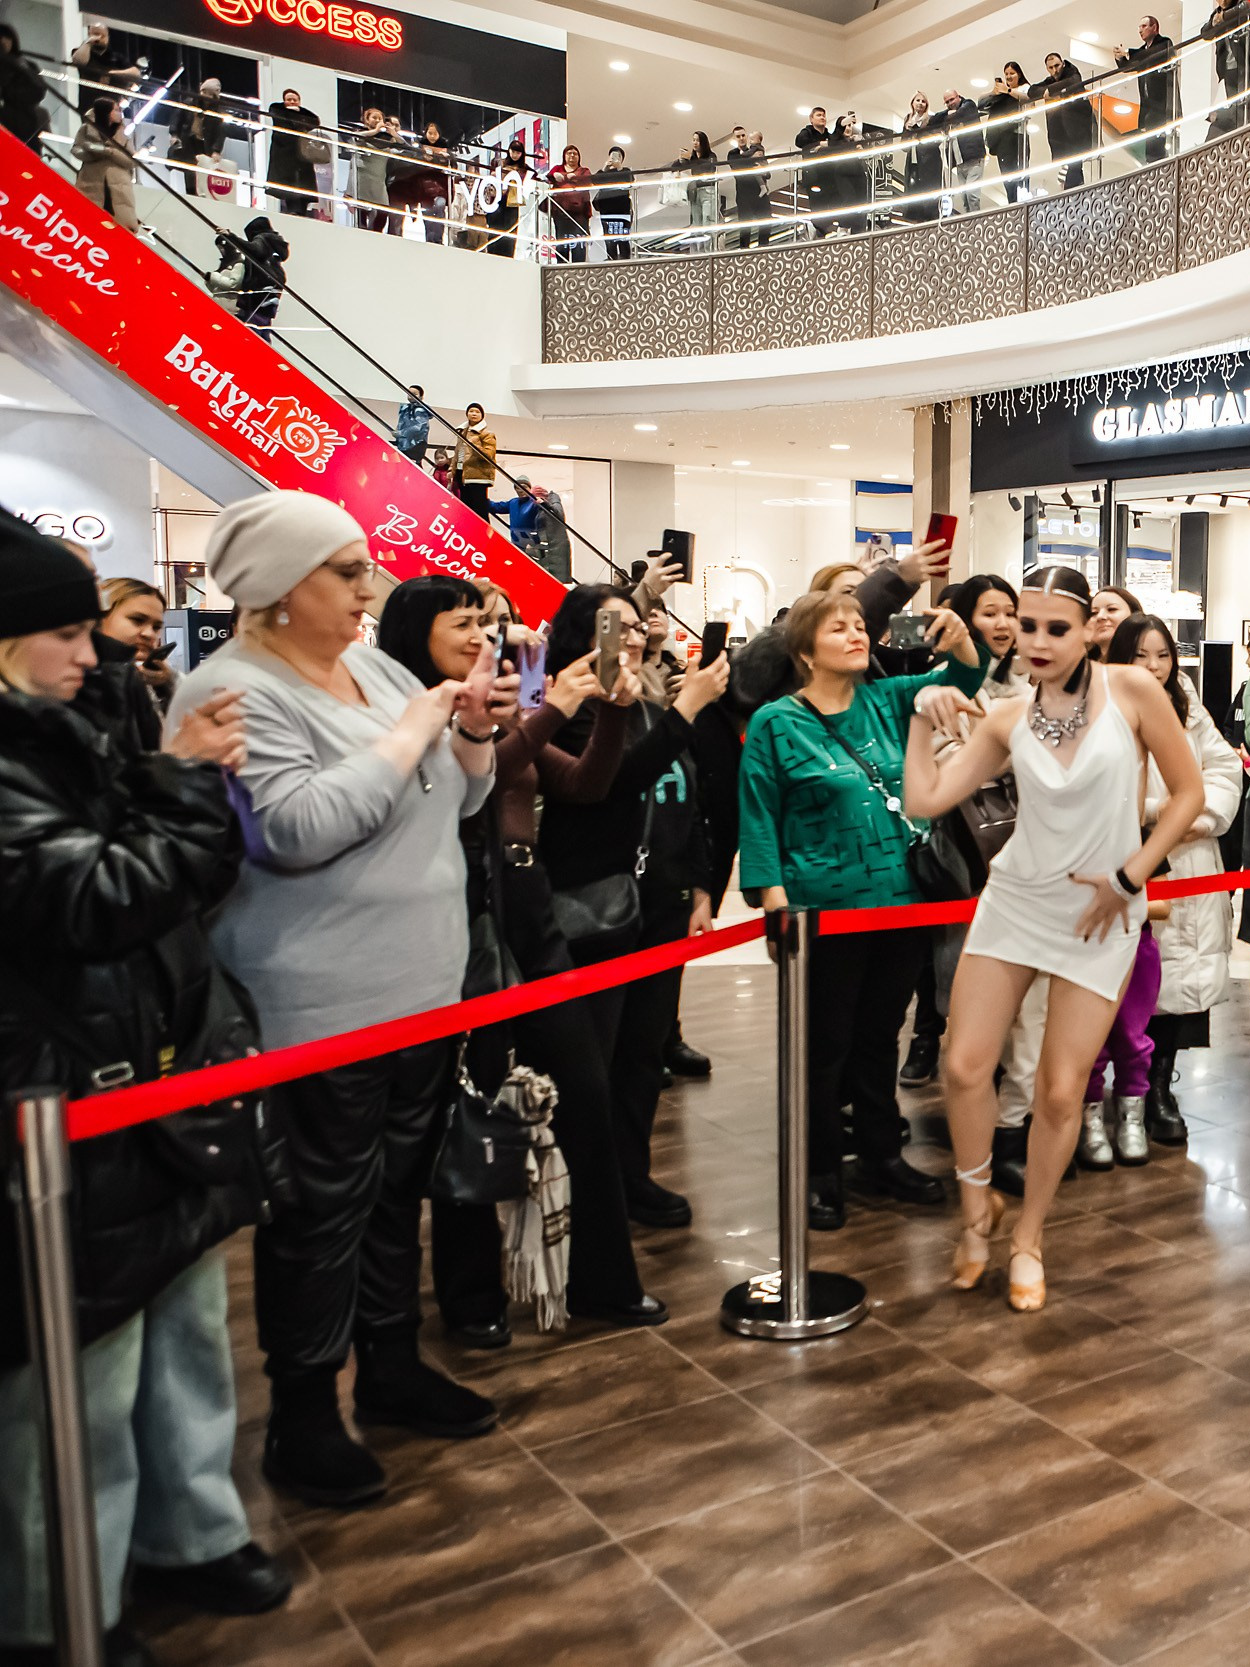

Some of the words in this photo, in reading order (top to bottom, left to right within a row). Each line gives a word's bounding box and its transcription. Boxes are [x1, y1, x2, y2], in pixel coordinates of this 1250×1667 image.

[0, 190, 119, 295] месте
[25, 193, 109, 267] Бірге
[164, 334, 265, 422] Batyr
[231, 417, 280, 457] mall
[371, 504, 490, 582] Вмест
[429, 514, 487, 568] Бірге
